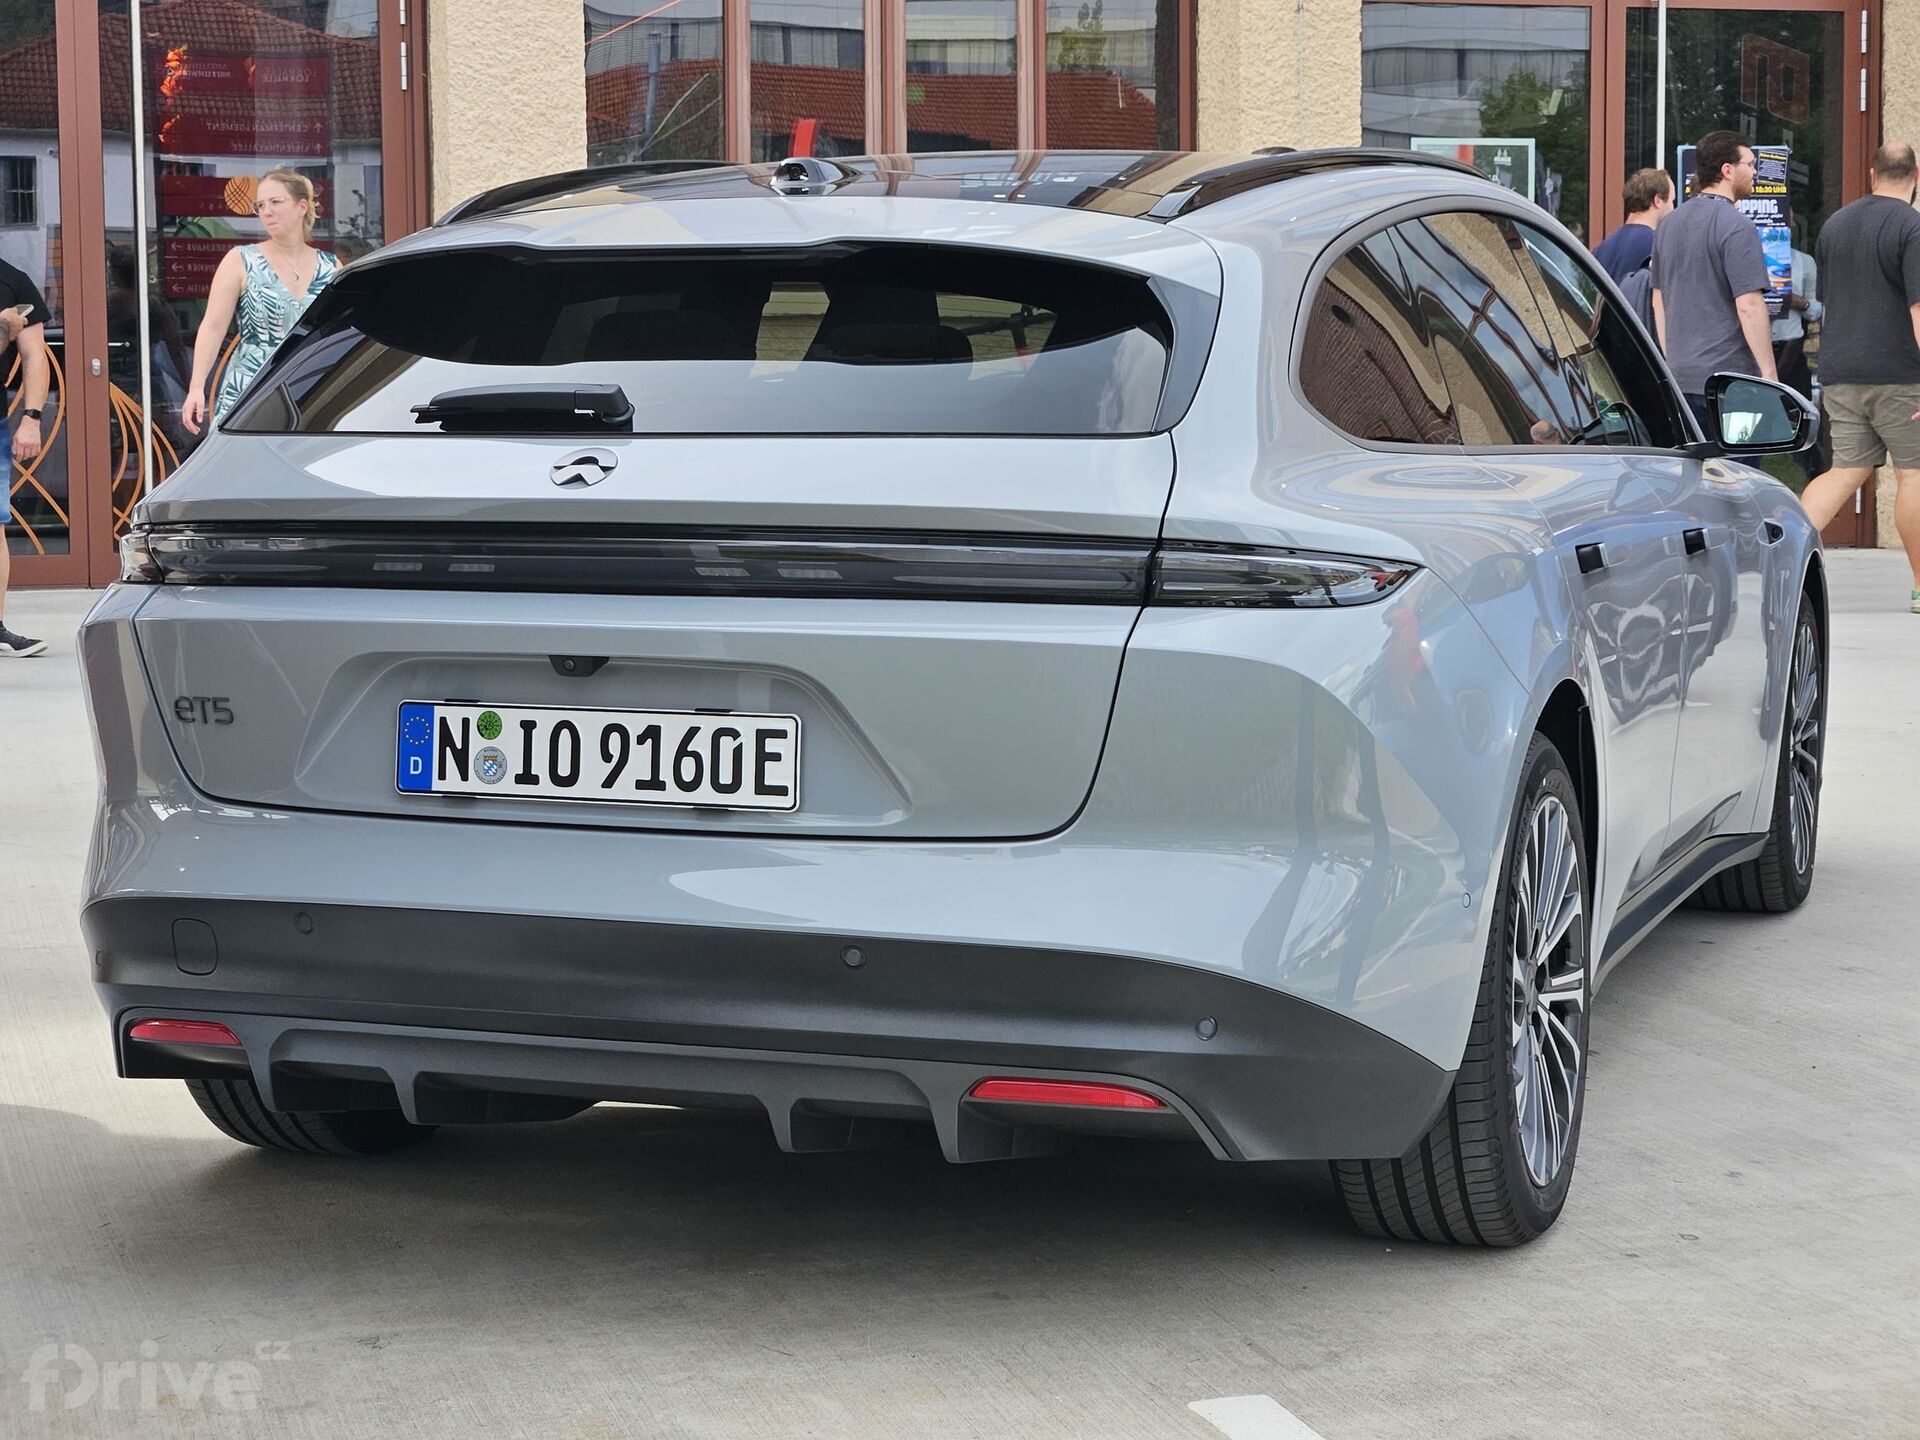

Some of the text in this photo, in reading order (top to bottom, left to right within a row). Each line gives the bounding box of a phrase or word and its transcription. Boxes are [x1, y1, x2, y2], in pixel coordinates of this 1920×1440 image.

[410, 716, 789, 796] D N IO 9160E
